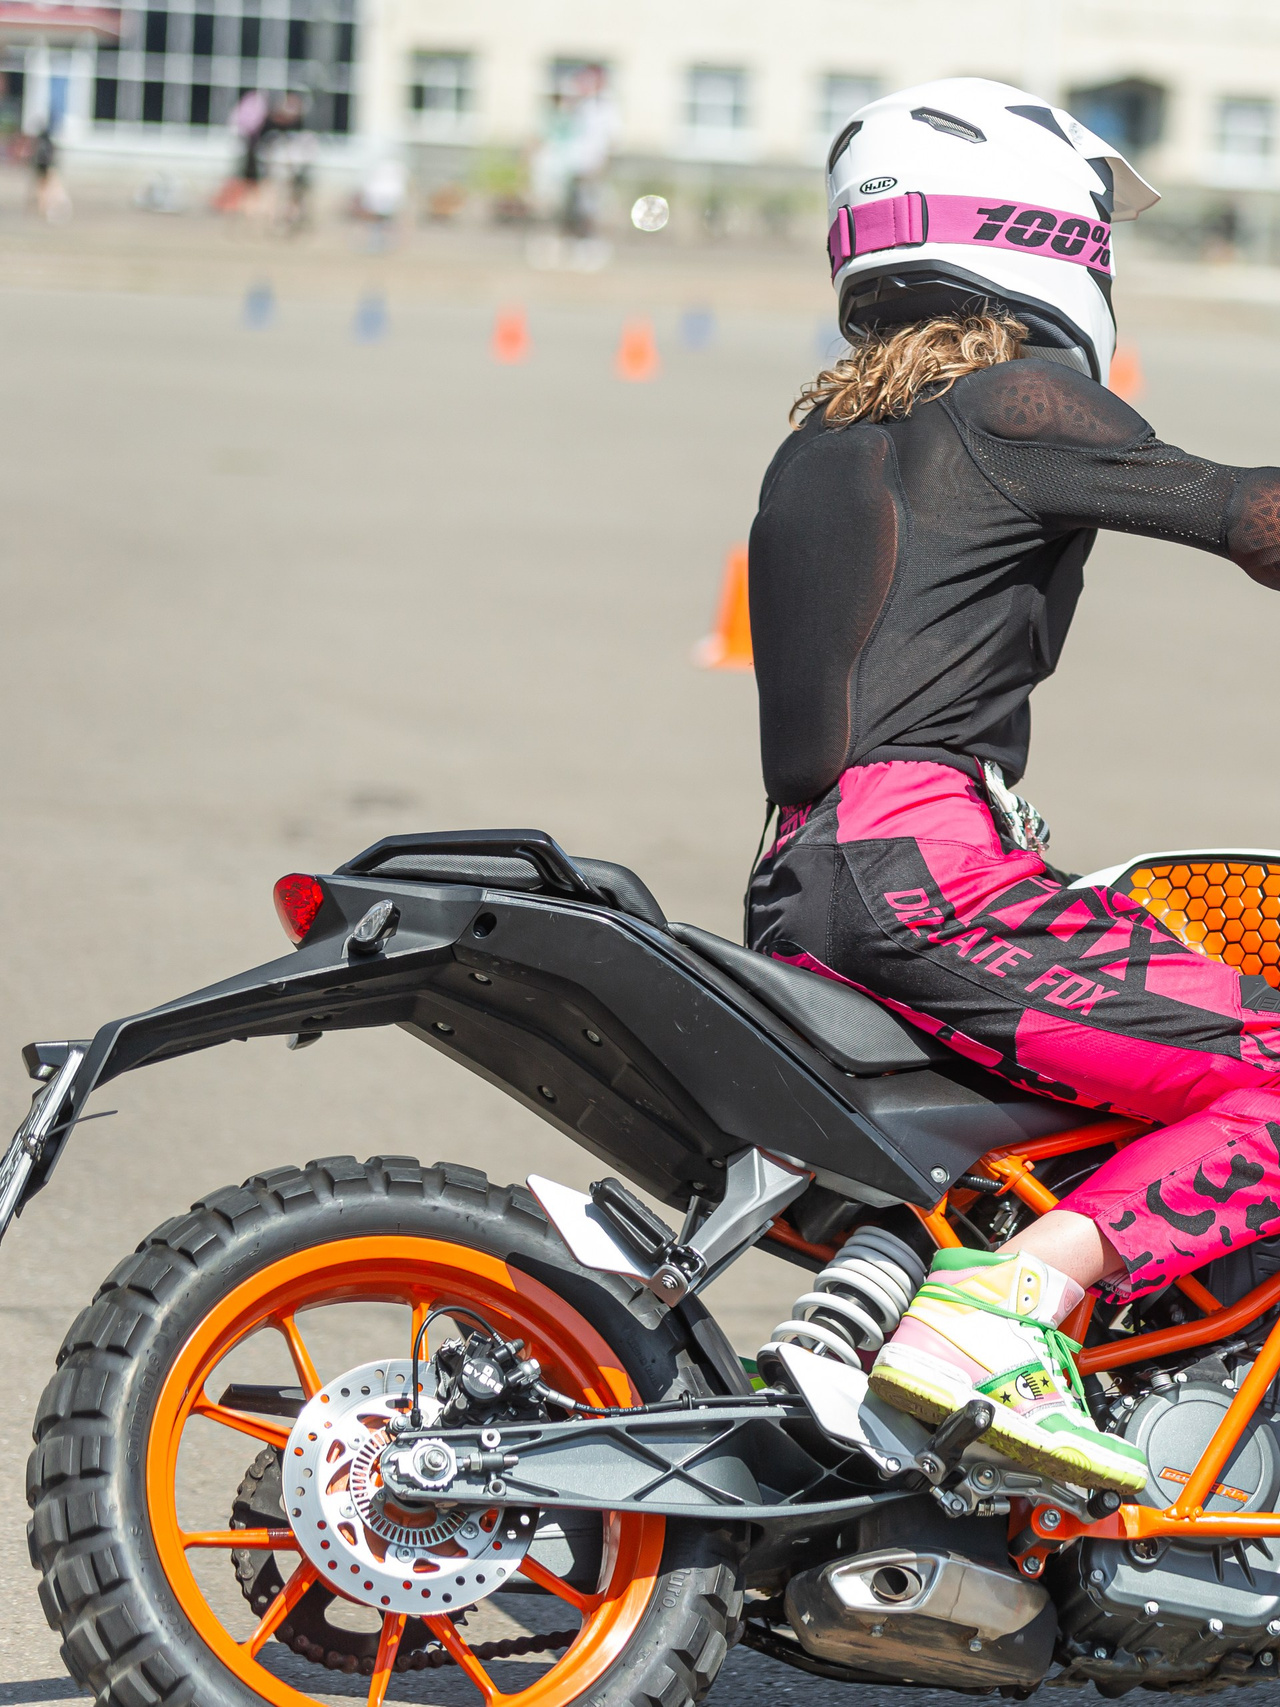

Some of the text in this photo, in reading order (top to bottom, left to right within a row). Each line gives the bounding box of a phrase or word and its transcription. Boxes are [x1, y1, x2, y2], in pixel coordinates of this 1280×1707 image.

[864, 179, 892, 192] HJC
[973, 204, 1111, 267] 100%
[1024, 964, 1121, 1016] FOX
